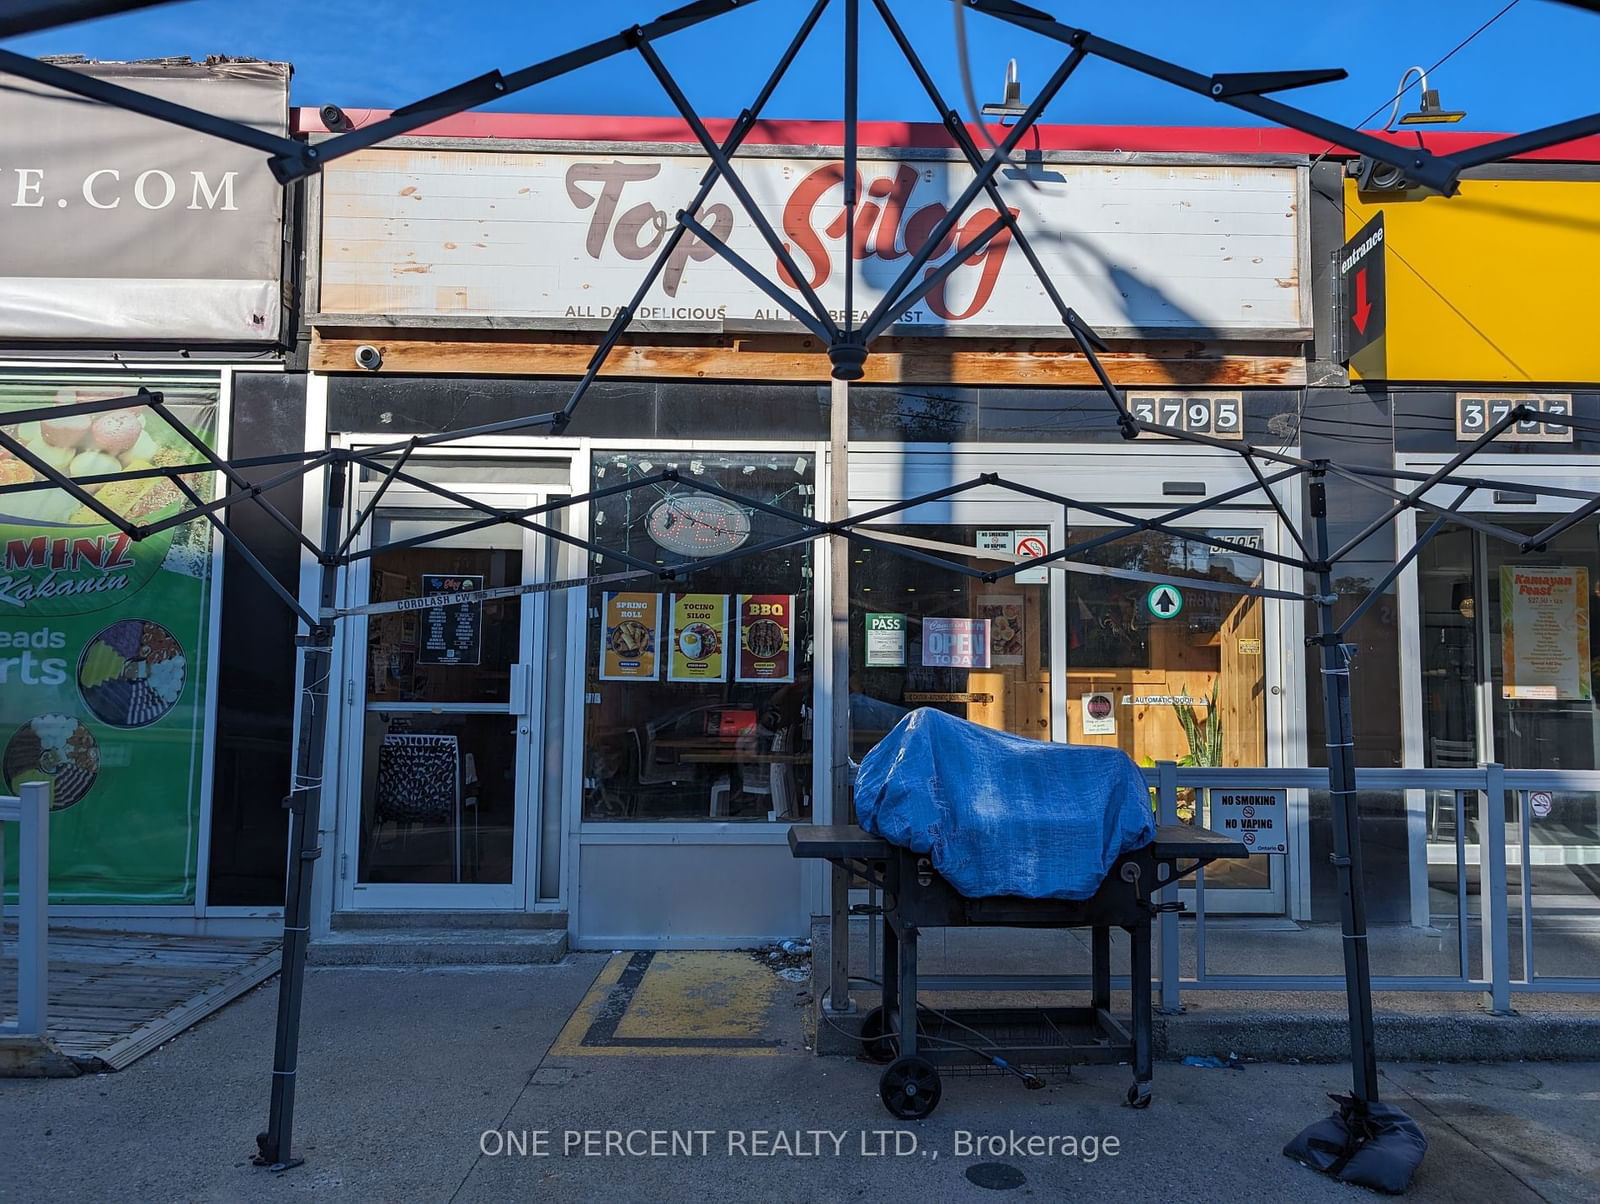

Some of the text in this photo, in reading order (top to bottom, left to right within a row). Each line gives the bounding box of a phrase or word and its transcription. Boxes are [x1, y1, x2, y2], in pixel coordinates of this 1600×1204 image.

[0, 168, 239, 211] E.COM
[565, 160, 1020, 321] Top Silog
[1341, 227, 1383, 274] entrance
[565, 305, 595, 318] ALL
[640, 306, 726, 320] DELICIOUS
[754, 308, 784, 321] ALL
[1135, 404, 1237, 428] 3795
[0, 531, 135, 573] MINZ
[1514, 574, 1572, 587] Kamayan
[0, 571, 129, 608] Kakanin
[1519, 586, 1552, 596] Feast
[397, 592, 450, 611] CORDLASH
[455, 588, 471, 603] CW
[749, 604, 784, 616] BBQ
[872, 618, 901, 630] PASS
[928, 633, 985, 655] OPEN
[933, 655, 980, 665] TODAY
[1135, 696, 1172, 704] AUTOMATIC
[1222, 795, 1276, 806] NO SMOKING
[1225, 819, 1273, 829] NO VAPING
